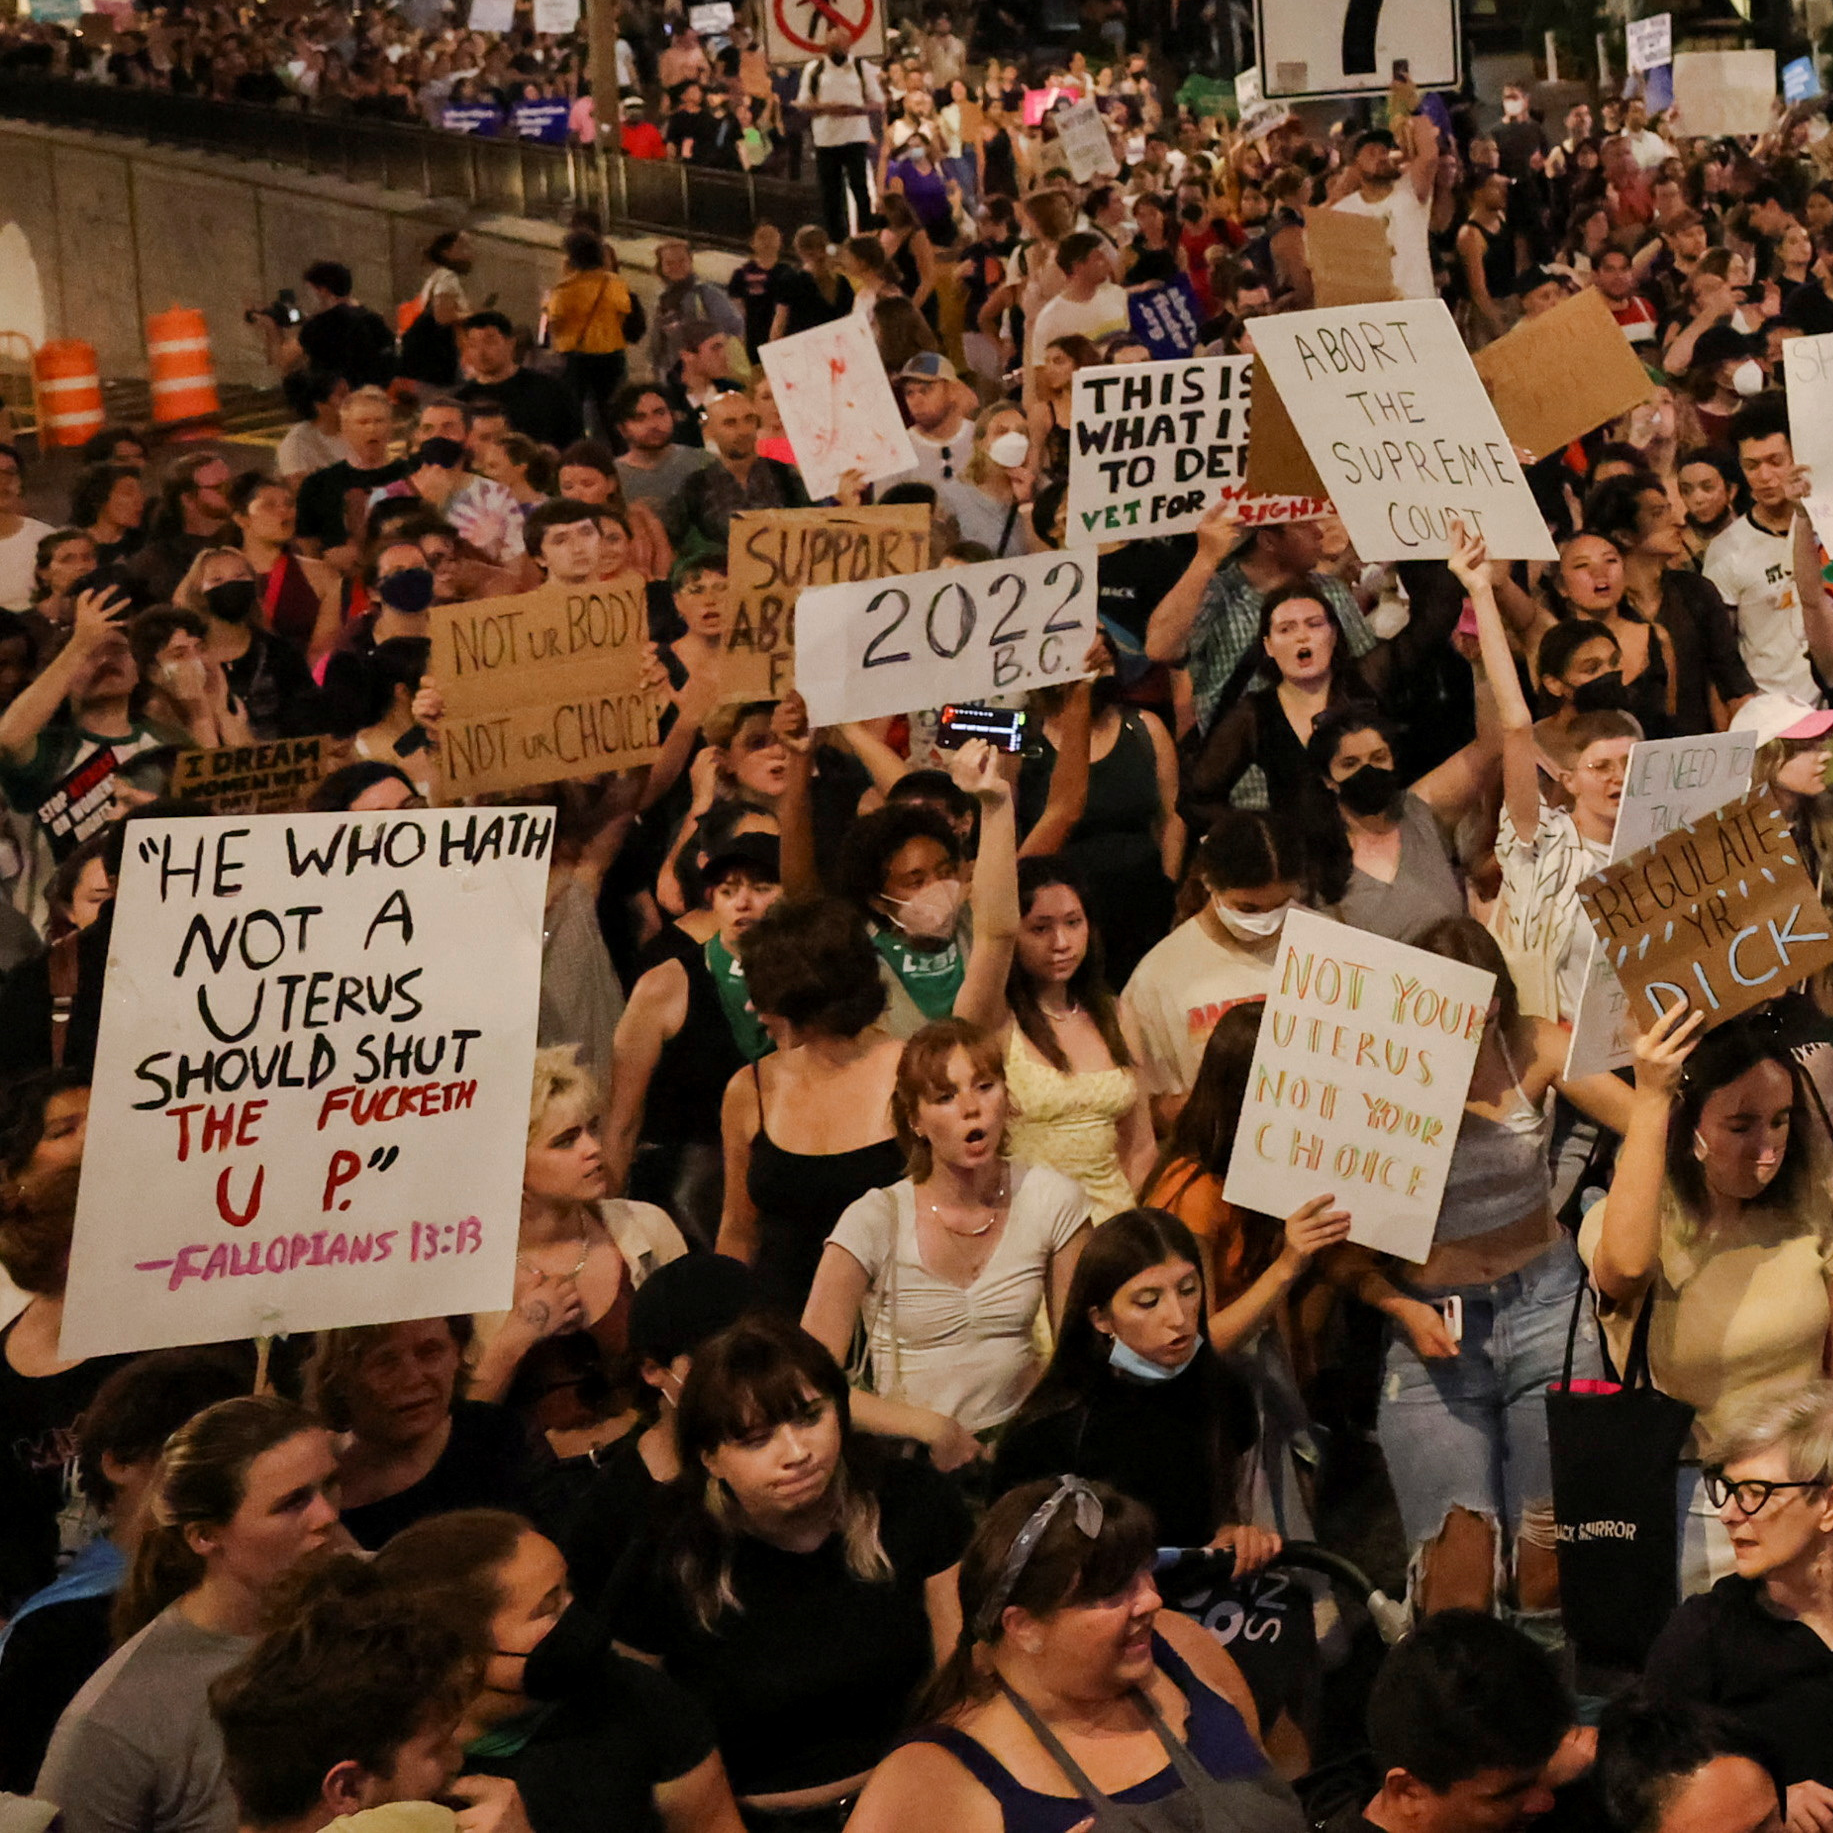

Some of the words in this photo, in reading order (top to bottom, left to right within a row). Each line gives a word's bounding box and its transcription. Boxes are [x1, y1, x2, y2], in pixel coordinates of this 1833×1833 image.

[1295, 319, 1411, 382] ABORT
[1082, 366, 1205, 415] THIS
[1346, 391, 1426, 426] THE
[1076, 409, 1206, 456] WHAT
[1330, 438, 1516, 488] SUPREME
[1099, 455, 1156, 494] TO
[1081, 498, 1142, 532] VET
[1149, 489, 1206, 524] FOR
[745, 526, 931, 590] SUPPORT
[450, 610, 525, 676] NOT
[564, 589, 648, 653] BODY
[861, 560, 1086, 670] 2022
[992, 635, 1072, 688] B.C.
[183, 754, 200, 779] I
[212, 739, 321, 775] DREAM
[442, 718, 512, 780] NOT
[551, 689, 667, 765] CHOICE
[1663, 747, 1717, 791] NEED
[138, 827, 251, 903] "HE
[284, 819, 426, 878] WHO
[439, 811, 553, 870] HATH
[1591, 805, 1778, 938] REGULATE
[173, 904, 323, 979] NOT
[365, 888, 415, 951] A
[1681, 895, 1742, 949] YR
[1644, 902, 1830, 1019] DICK
[197, 967, 424, 1044] UTERUS
[1279, 946, 1374, 1007] NOT
[1390, 974, 1489, 1041] YOUR
[133, 1034, 335, 1112] SHOULD
[353, 1028, 483, 1085] SHUT
[1269, 1013, 1435, 1087] UTERUS
[165, 1097, 270, 1162] THE
[317, 1077, 478, 1132] FUCKETH
[1255, 1063, 1355, 1124] NOT
[1362, 1095, 1445, 1147] YOUR
[1253, 1120, 1429, 1200] CHOICE
[215, 1164, 265, 1227] U
[409, 1215, 484, 1264] 13:13
[1578, 1521, 1637, 1541] MIRROR
